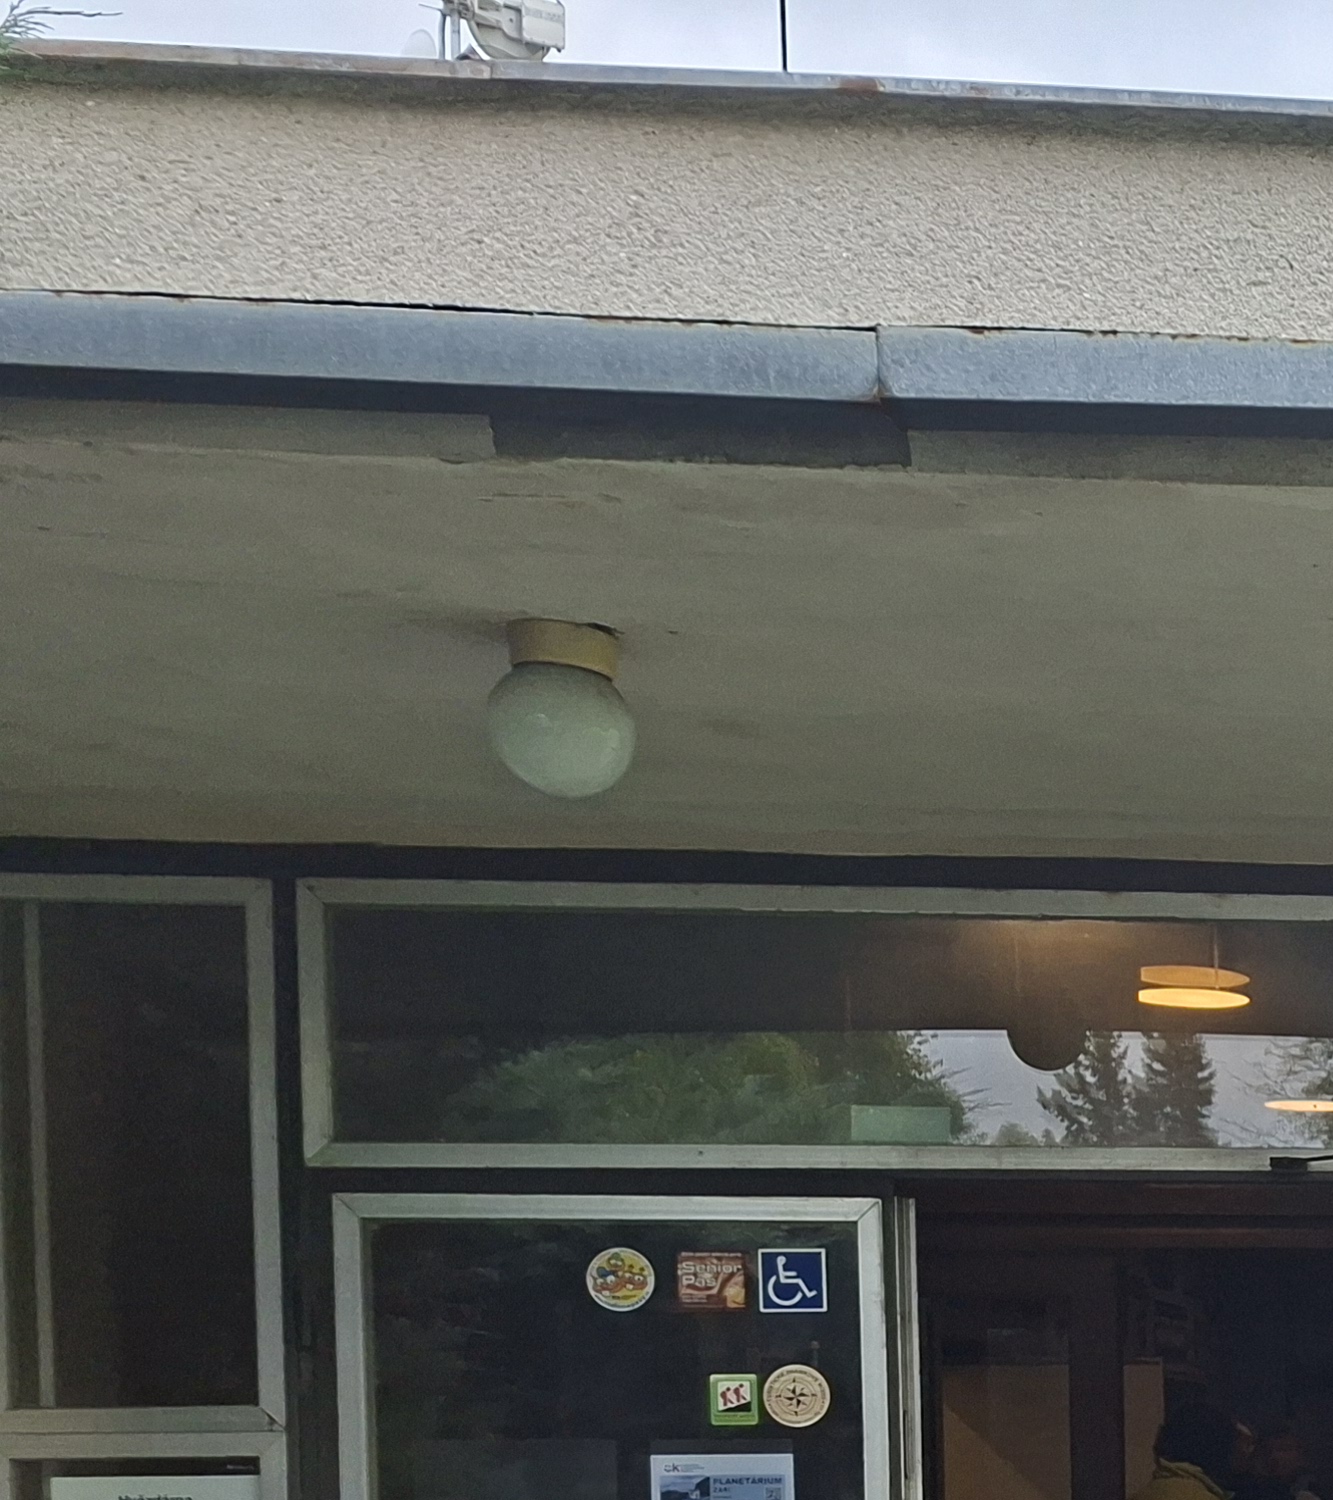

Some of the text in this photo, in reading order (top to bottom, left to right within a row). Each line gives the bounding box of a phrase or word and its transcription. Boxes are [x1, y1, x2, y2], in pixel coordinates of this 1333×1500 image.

[682, 1261, 742, 1273] Senior
[682, 1275, 717, 1287] Pas
[713, 1477, 782, 1485] PLANETÁRIUM
